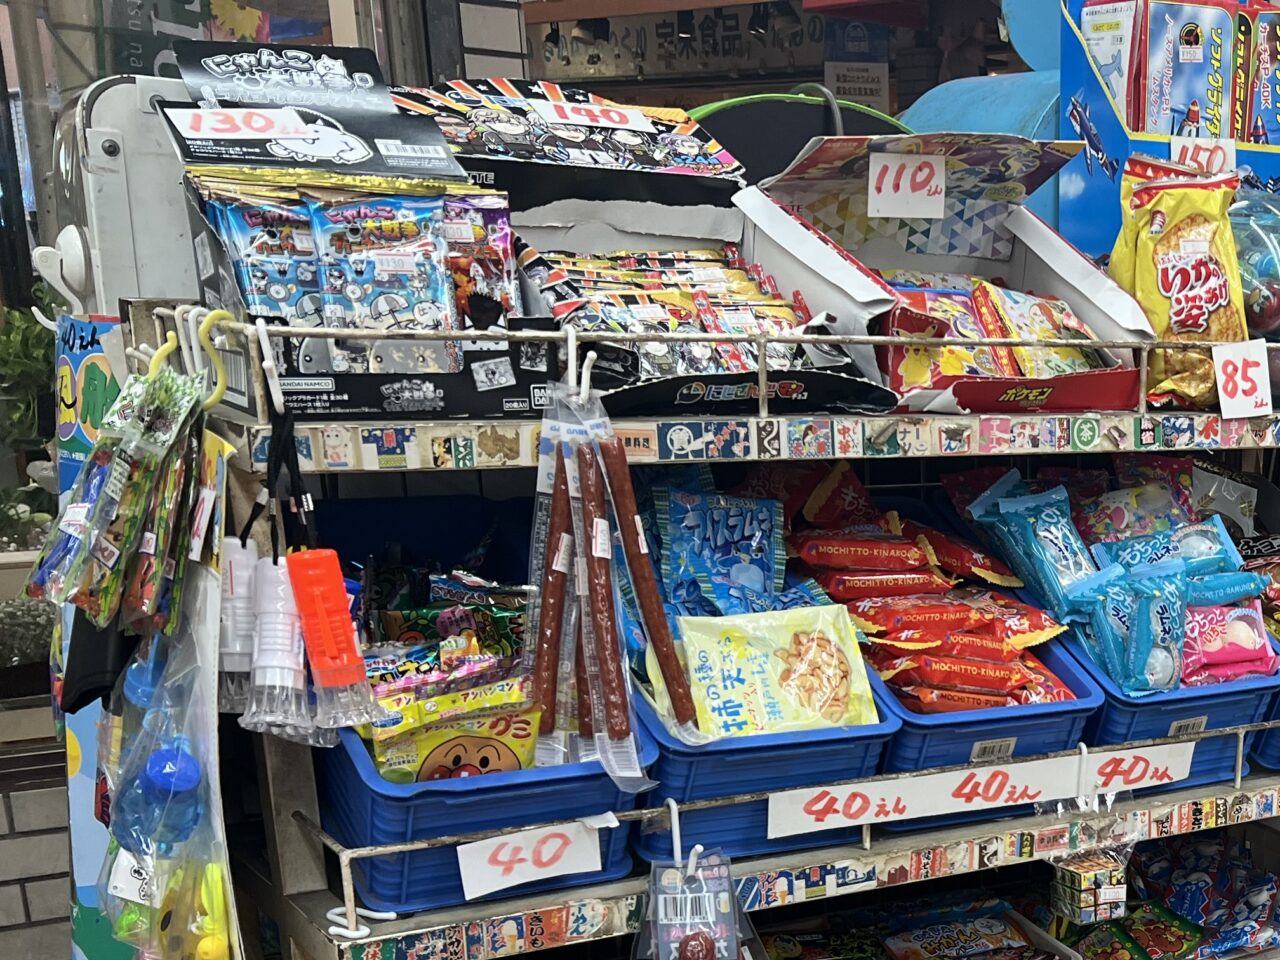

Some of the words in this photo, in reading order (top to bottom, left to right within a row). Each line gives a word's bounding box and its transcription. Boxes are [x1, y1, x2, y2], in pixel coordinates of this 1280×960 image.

[1204, 27, 1222, 138] ソフトグライダ
[554, 103, 630, 126] 140
[325, 206, 396, 225] にゃんこ
[1000, 385, 1054, 402] ポケモン
[1078, 422, 1094, 443] 茶
[461, 681, 515, 703] アンパンマン
[489, 713, 532, 740] グミ
[486, 832, 573, 877] 40
[529, 908, 545, 949] きいも
